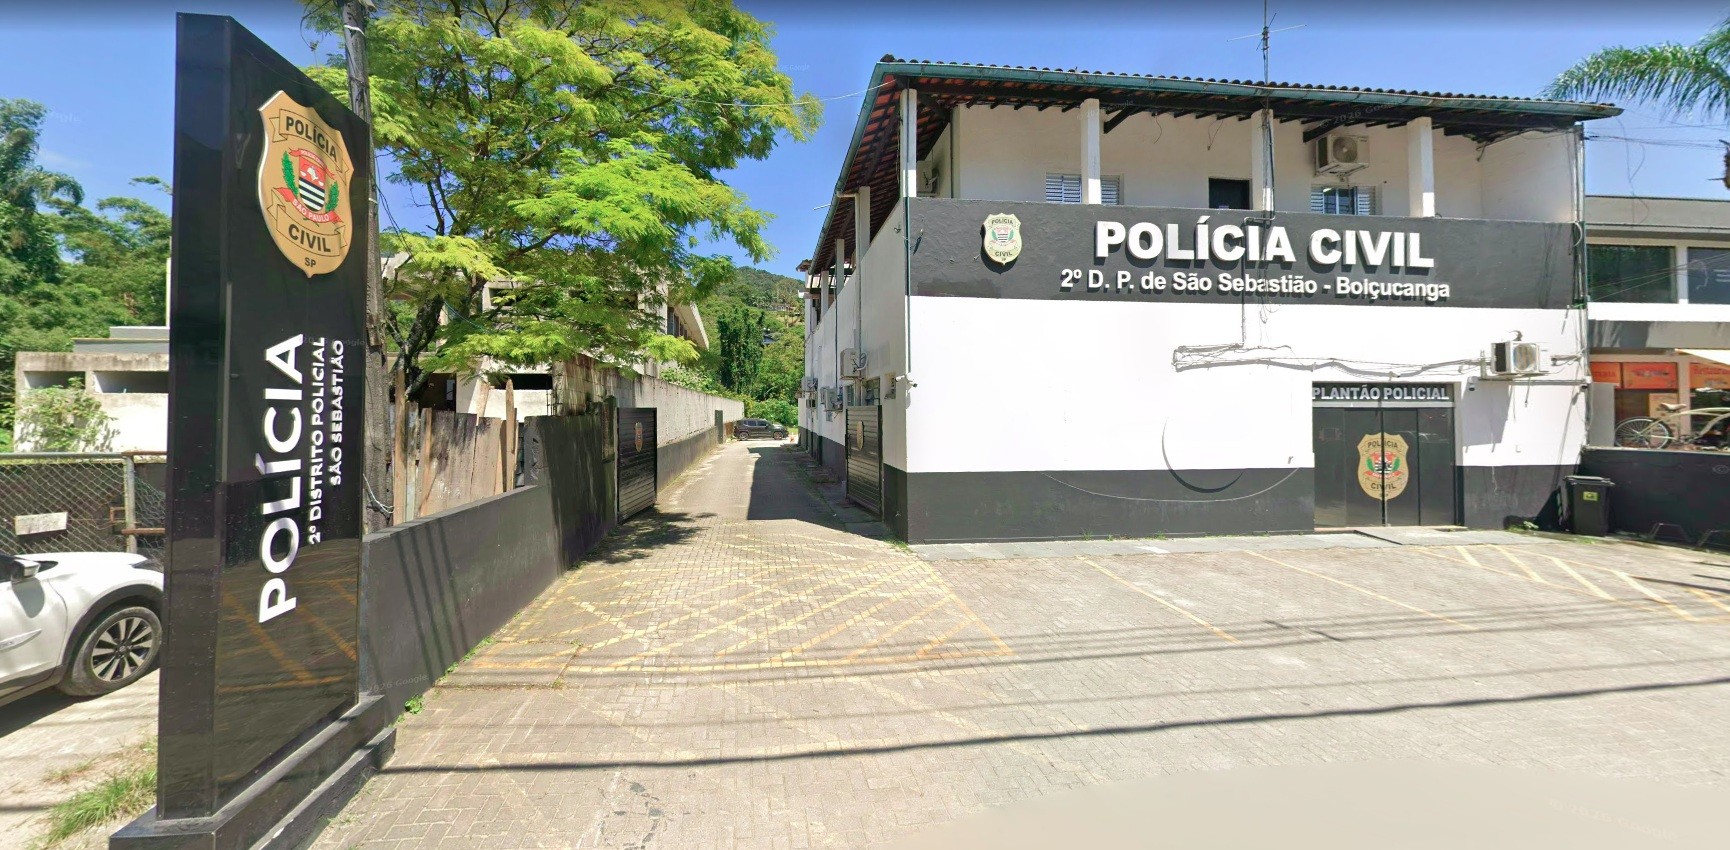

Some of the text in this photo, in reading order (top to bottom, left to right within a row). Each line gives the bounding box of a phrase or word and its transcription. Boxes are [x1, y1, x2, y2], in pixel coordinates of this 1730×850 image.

[285, 115, 338, 162] POLÍCIA
[288, 224, 331, 253] CIVIL
[308, 212, 330, 222] PAULO
[304, 257, 317, 268] SP
[1095, 215, 1435, 268] POLÍCIA CIVIL
[1060, 269, 1083, 289] 2º
[1087, 270, 1110, 290] D.
[1116, 271, 1135, 291] P.
[1140, 270, 1167, 291] de
[1172, 271, 1213, 293] São
[1218, 273, 1317, 295] Sebastião
[310, 336, 326, 427] POLICIAL
[1312, 383, 1450, 400] PLANTÃO POLICIAL
[328, 340, 344, 486] SÃO SEBASTIÃO
[254, 333, 304, 624] POLÍCIA
[308, 429, 324, 523] DISTRITO
